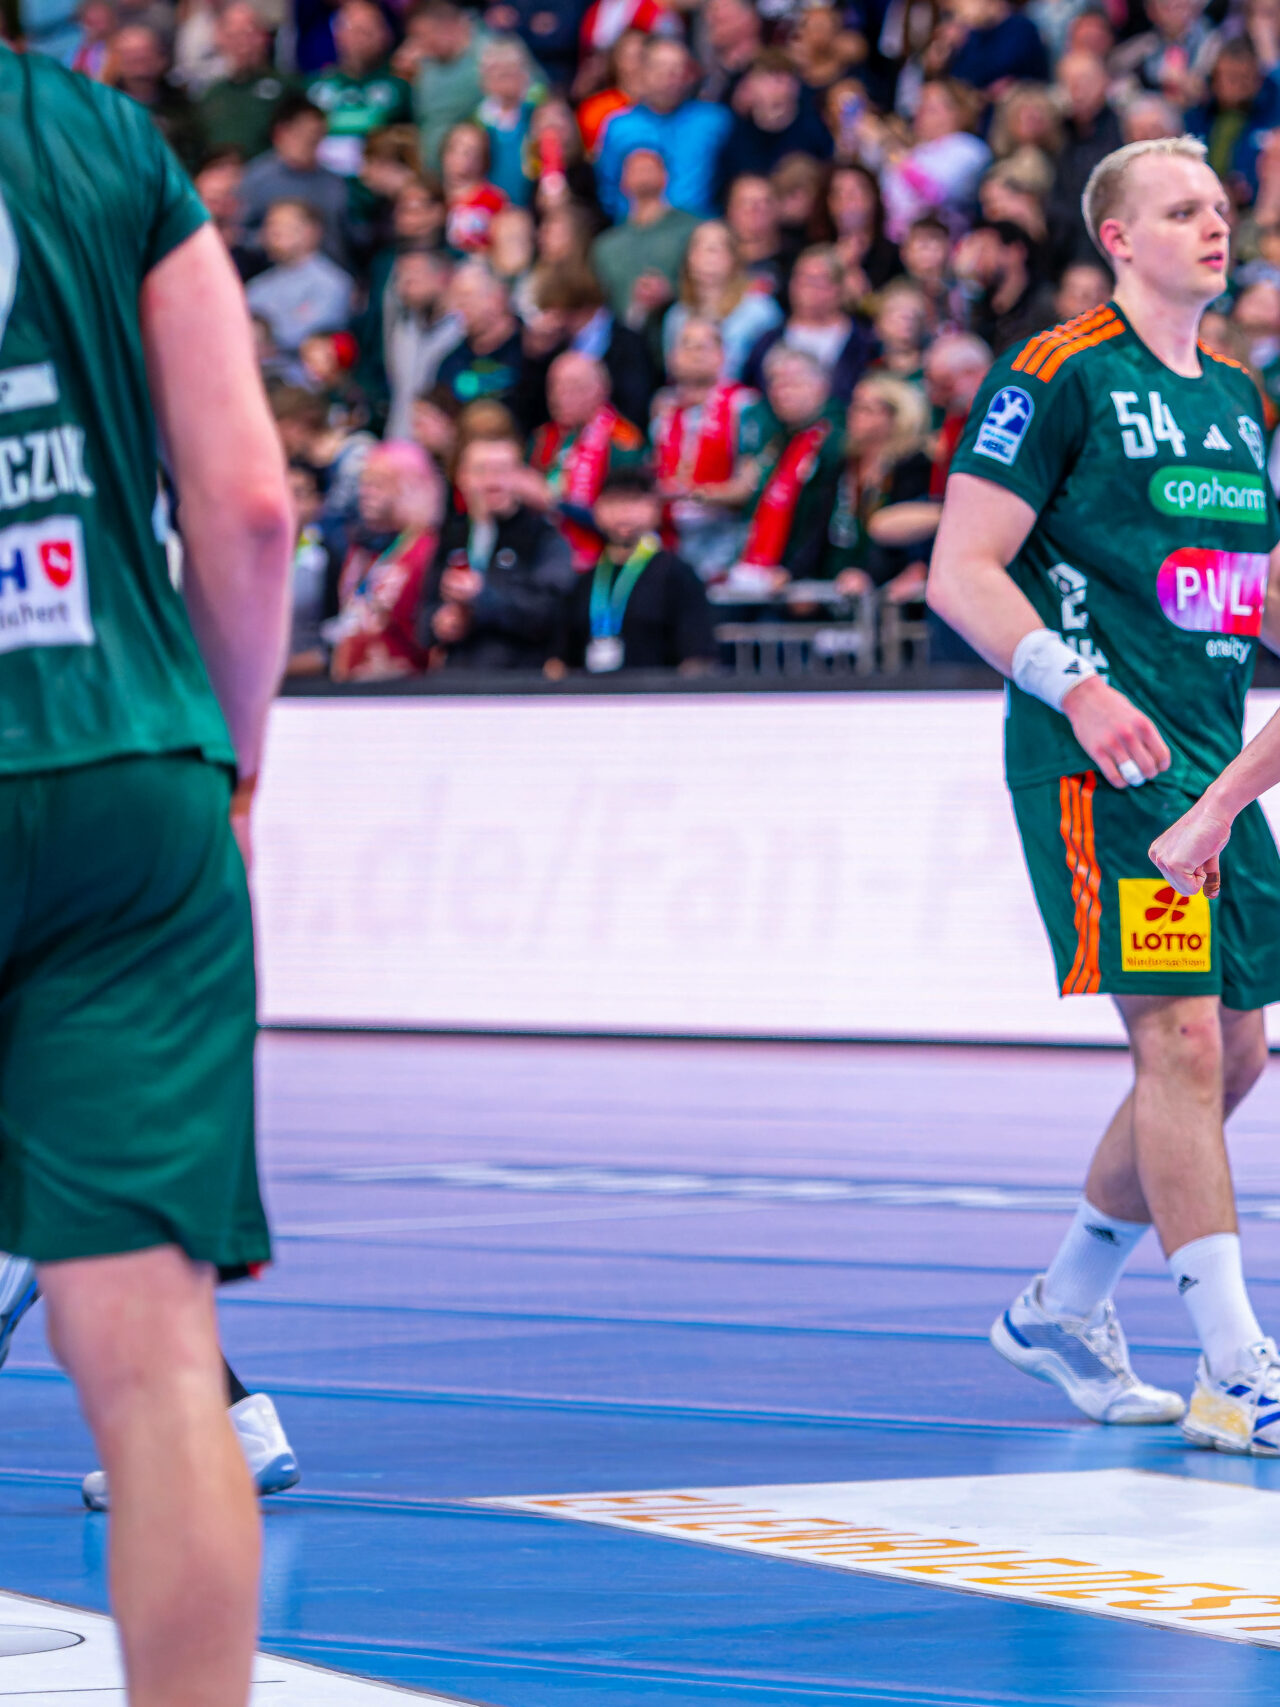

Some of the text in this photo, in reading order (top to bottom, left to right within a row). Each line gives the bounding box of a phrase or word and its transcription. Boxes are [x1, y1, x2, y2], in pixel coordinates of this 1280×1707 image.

[1110, 391, 1187, 459] 54
[1176, 566, 1268, 617] PUL
[1132, 932, 1202, 951] LOTTO
